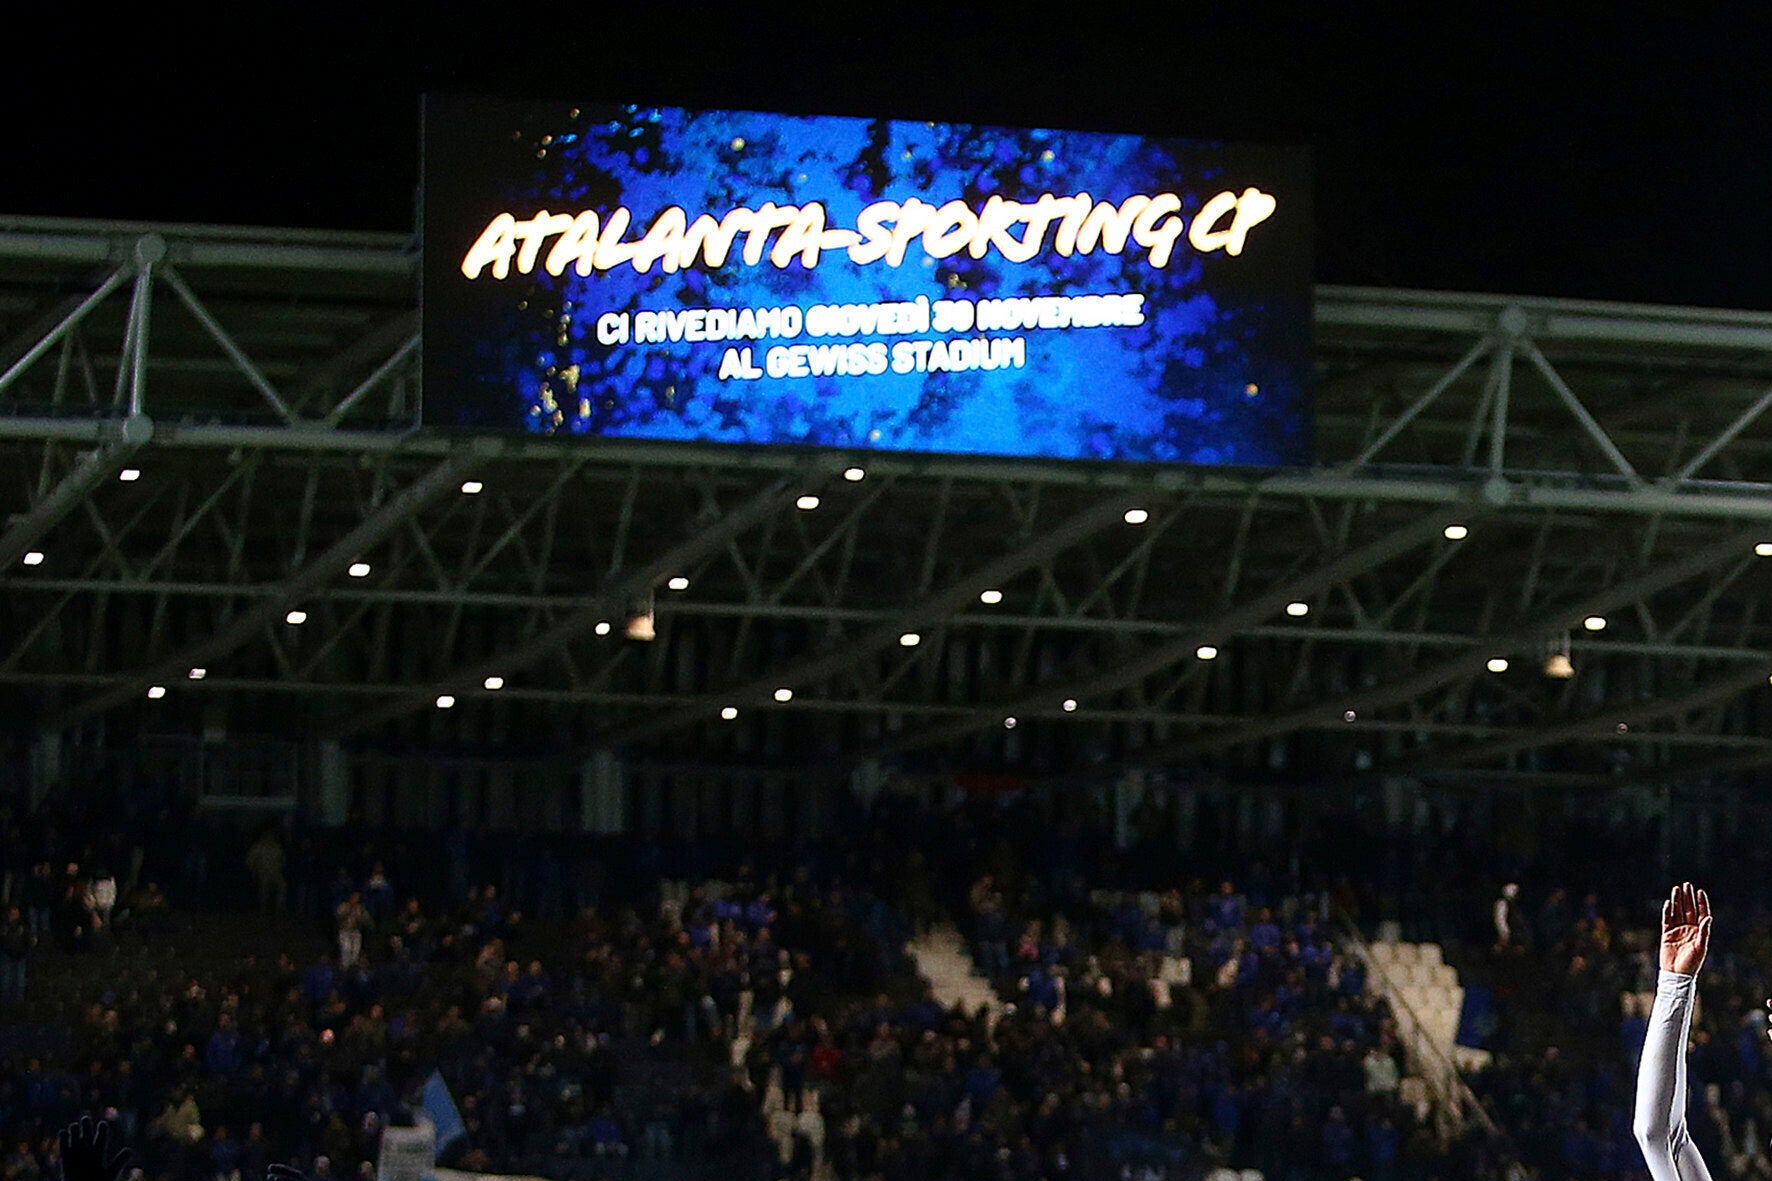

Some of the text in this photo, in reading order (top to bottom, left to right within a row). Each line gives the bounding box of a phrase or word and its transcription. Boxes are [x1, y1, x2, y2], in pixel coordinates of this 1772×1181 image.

[461, 187, 1276, 280] ATALANTA-SPORTING CP
[597, 313, 630, 345] CI
[635, 305, 803, 344] RIVEDIAMO
[932, 300, 975, 332] 30
[976, 294, 1145, 330] NOVEMBRE
[718, 337, 1025, 381] AL GEWISS STADIUM
